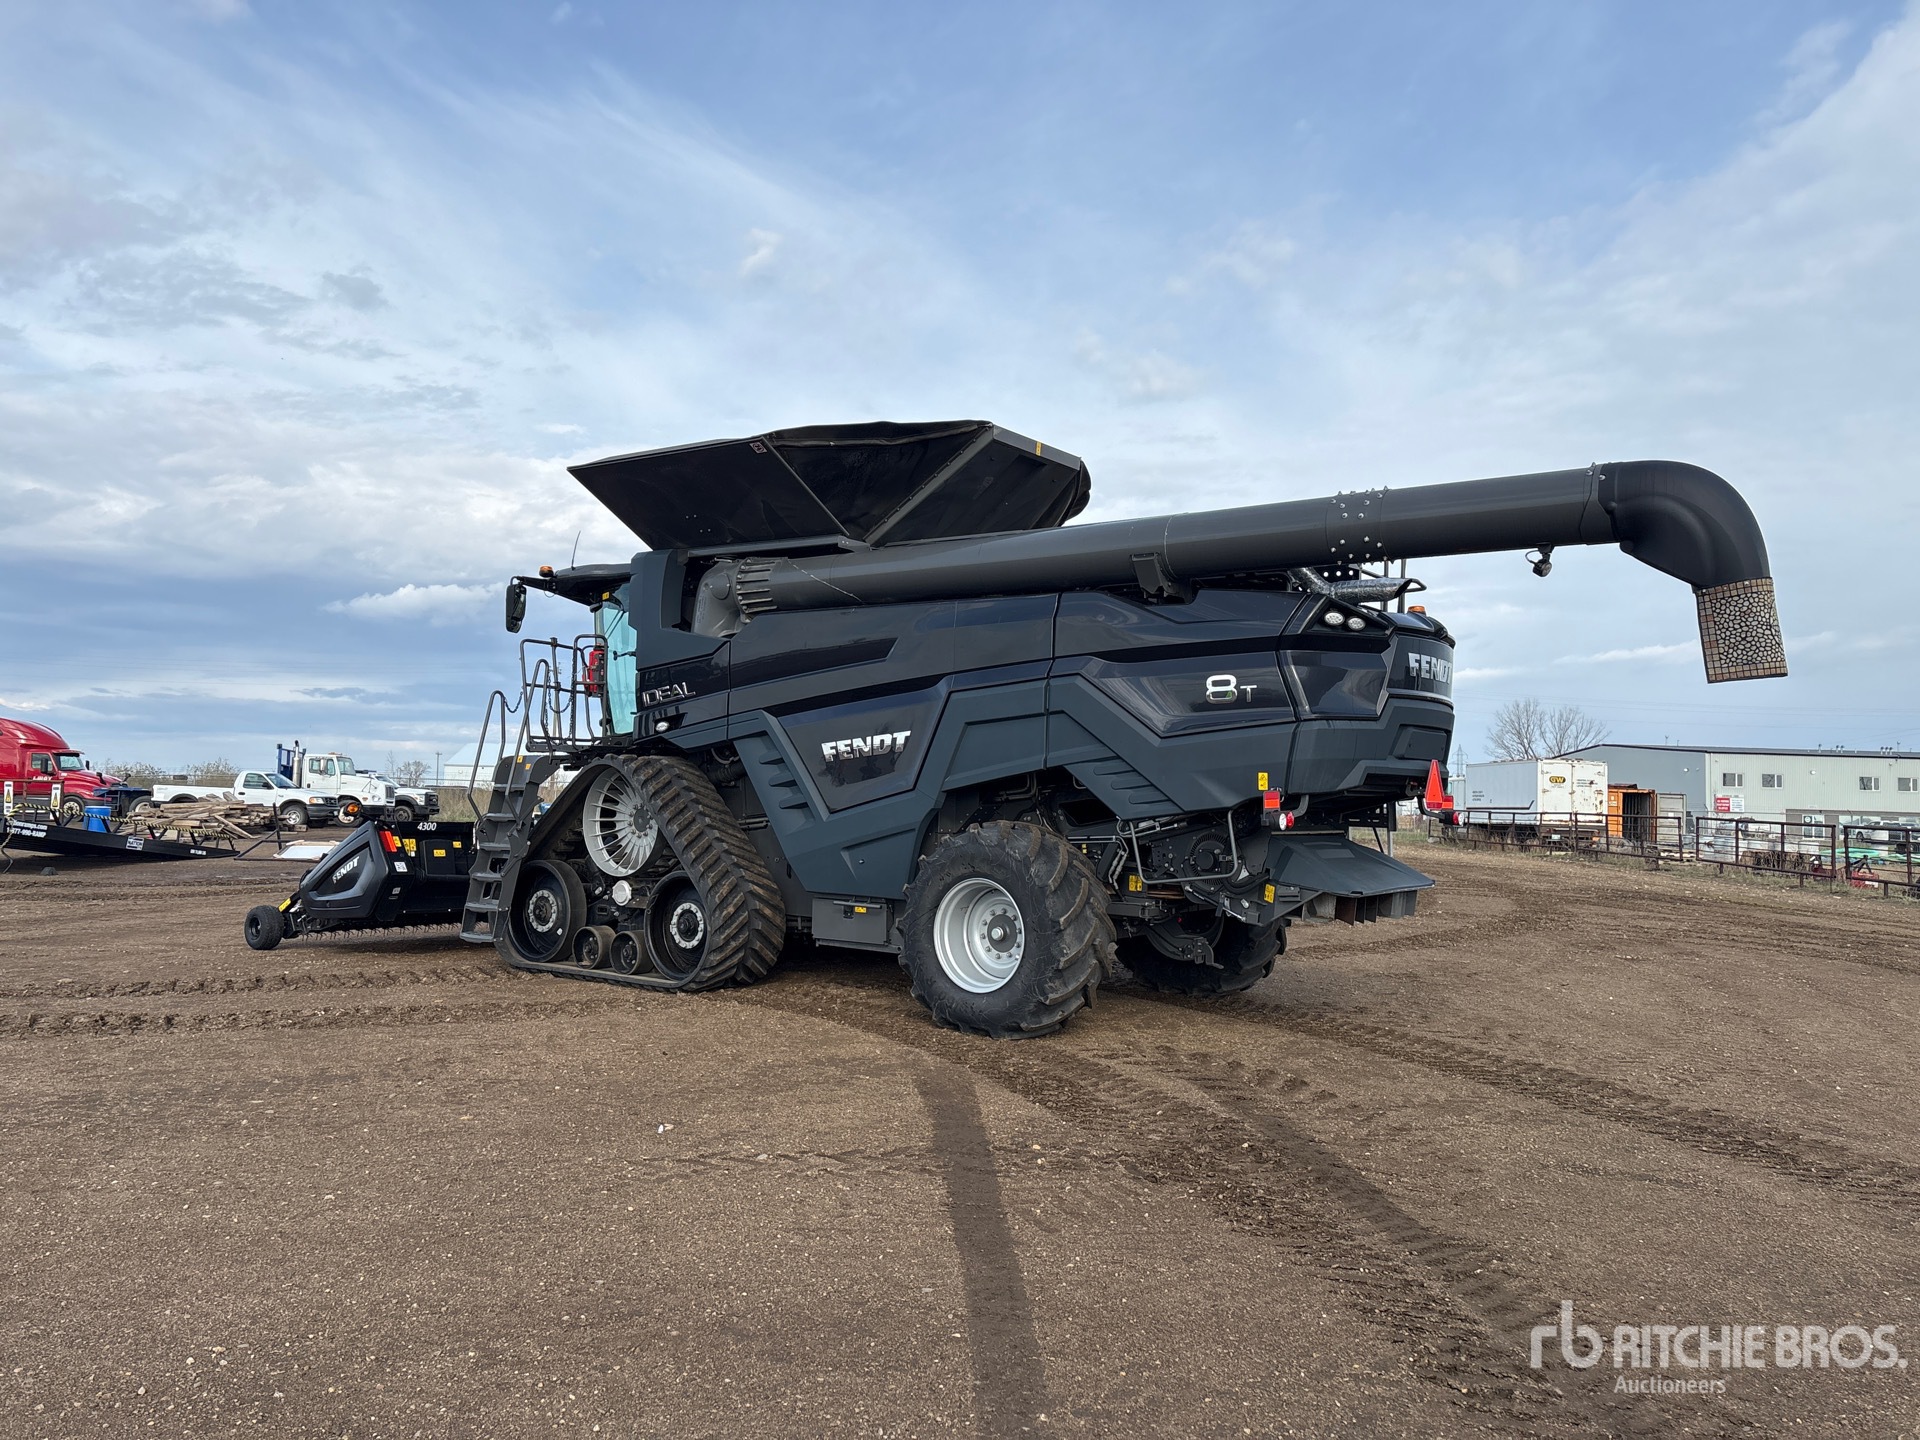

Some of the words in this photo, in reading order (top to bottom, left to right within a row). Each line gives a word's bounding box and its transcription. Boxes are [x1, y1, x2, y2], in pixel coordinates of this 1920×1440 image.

[1408, 652, 1453, 684] FENDT
[642, 682, 696, 707] IDEAL
[821, 730, 911, 762] FENDT
[417, 822, 437, 831] 4300
[332, 856, 360, 884] FENDT
